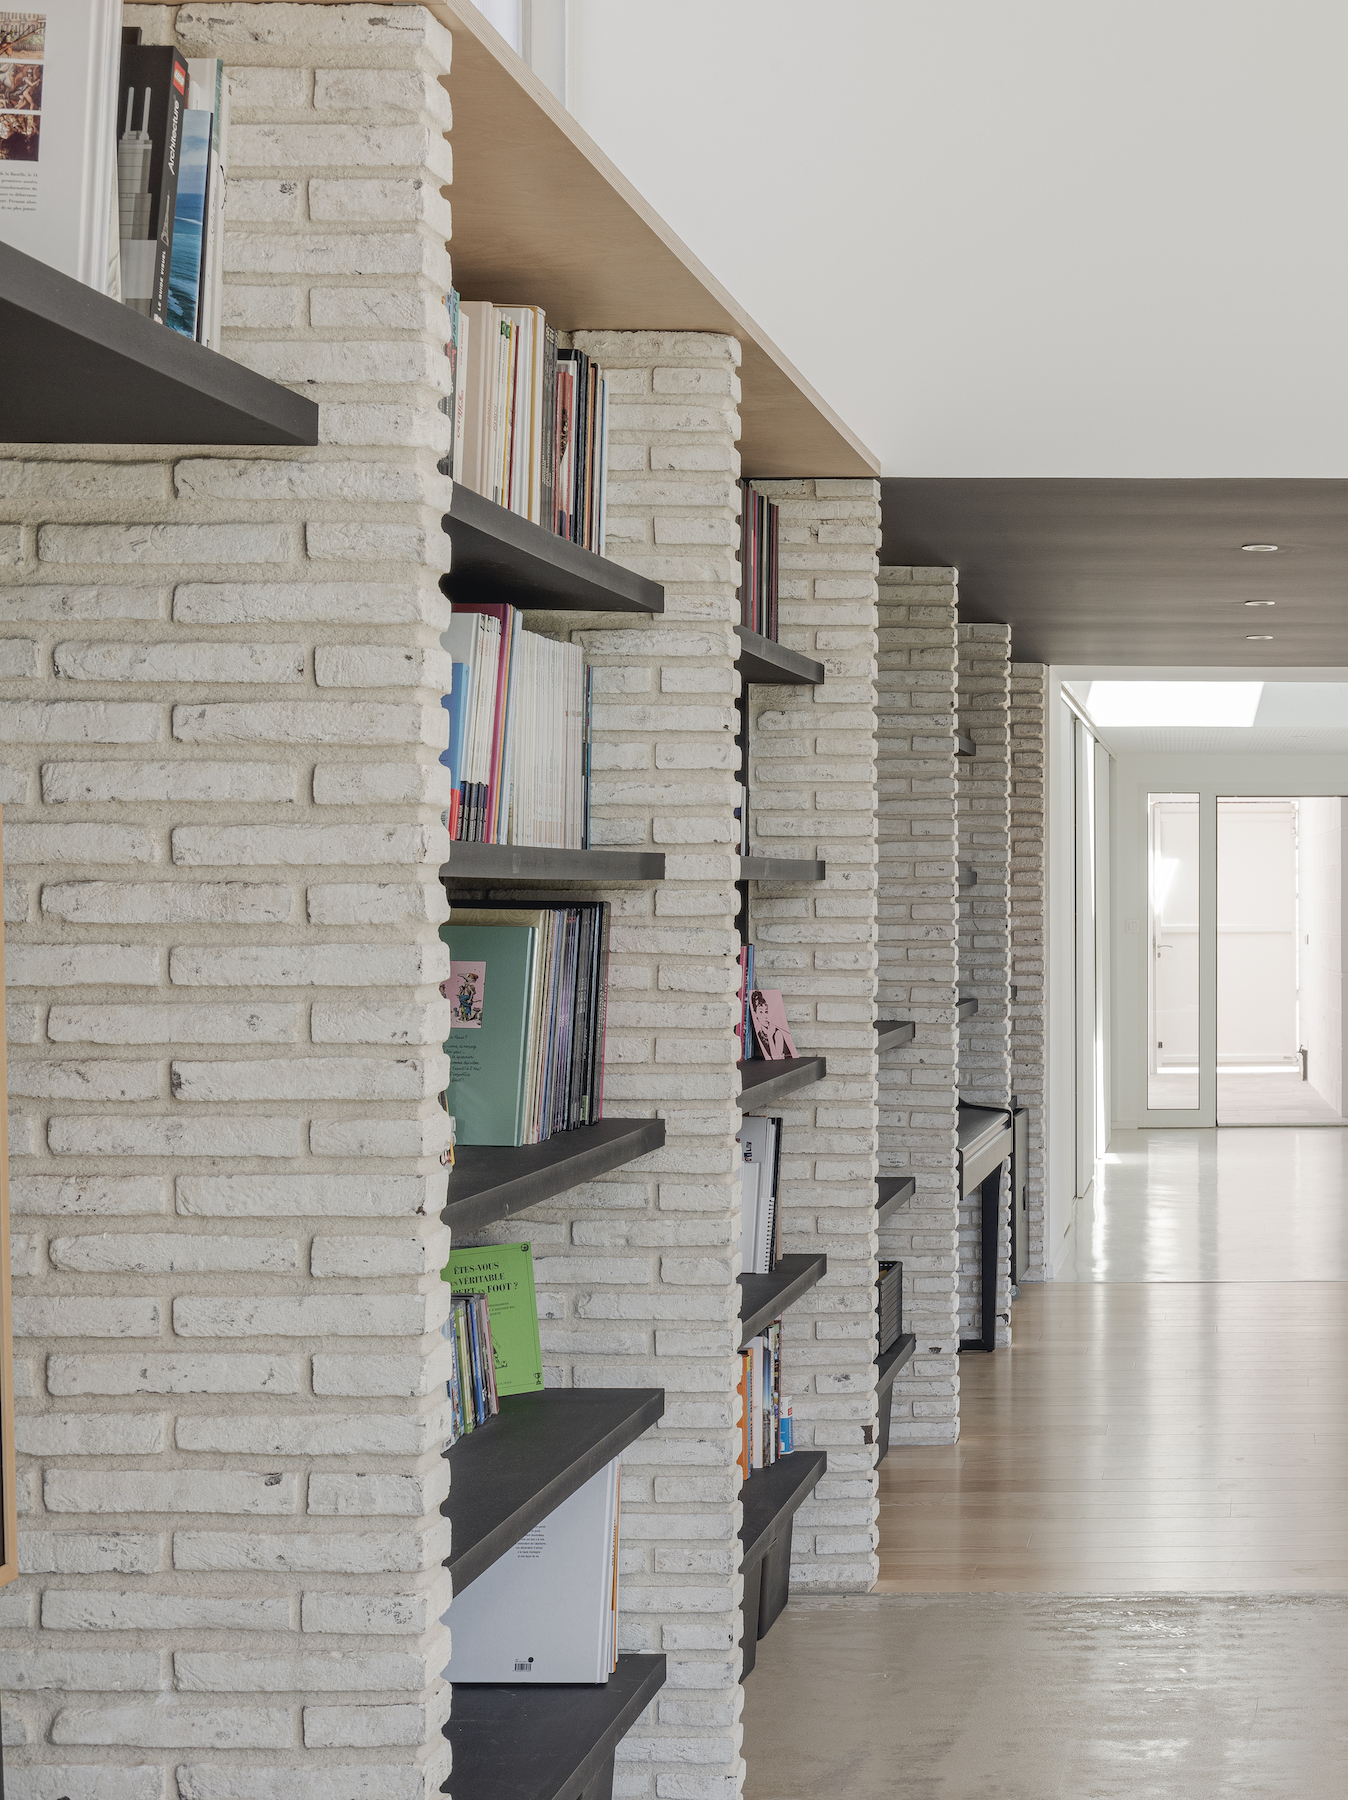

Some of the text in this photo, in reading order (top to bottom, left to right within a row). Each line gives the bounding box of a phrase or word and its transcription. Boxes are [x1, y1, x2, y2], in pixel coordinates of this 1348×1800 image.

[173, 68, 185, 87] LEGO
[167, 99, 181, 176] Architecture
[159, 250, 167, 275] VISUEL
[157, 301, 162, 312] LE
[454, 1262, 499, 1275] ÊTES-VOUS
[458, 1272, 505, 1286] VÉRITABLE
[487, 1284, 511, 1294] FOOT
[513, 1281, 518, 1290] ?
